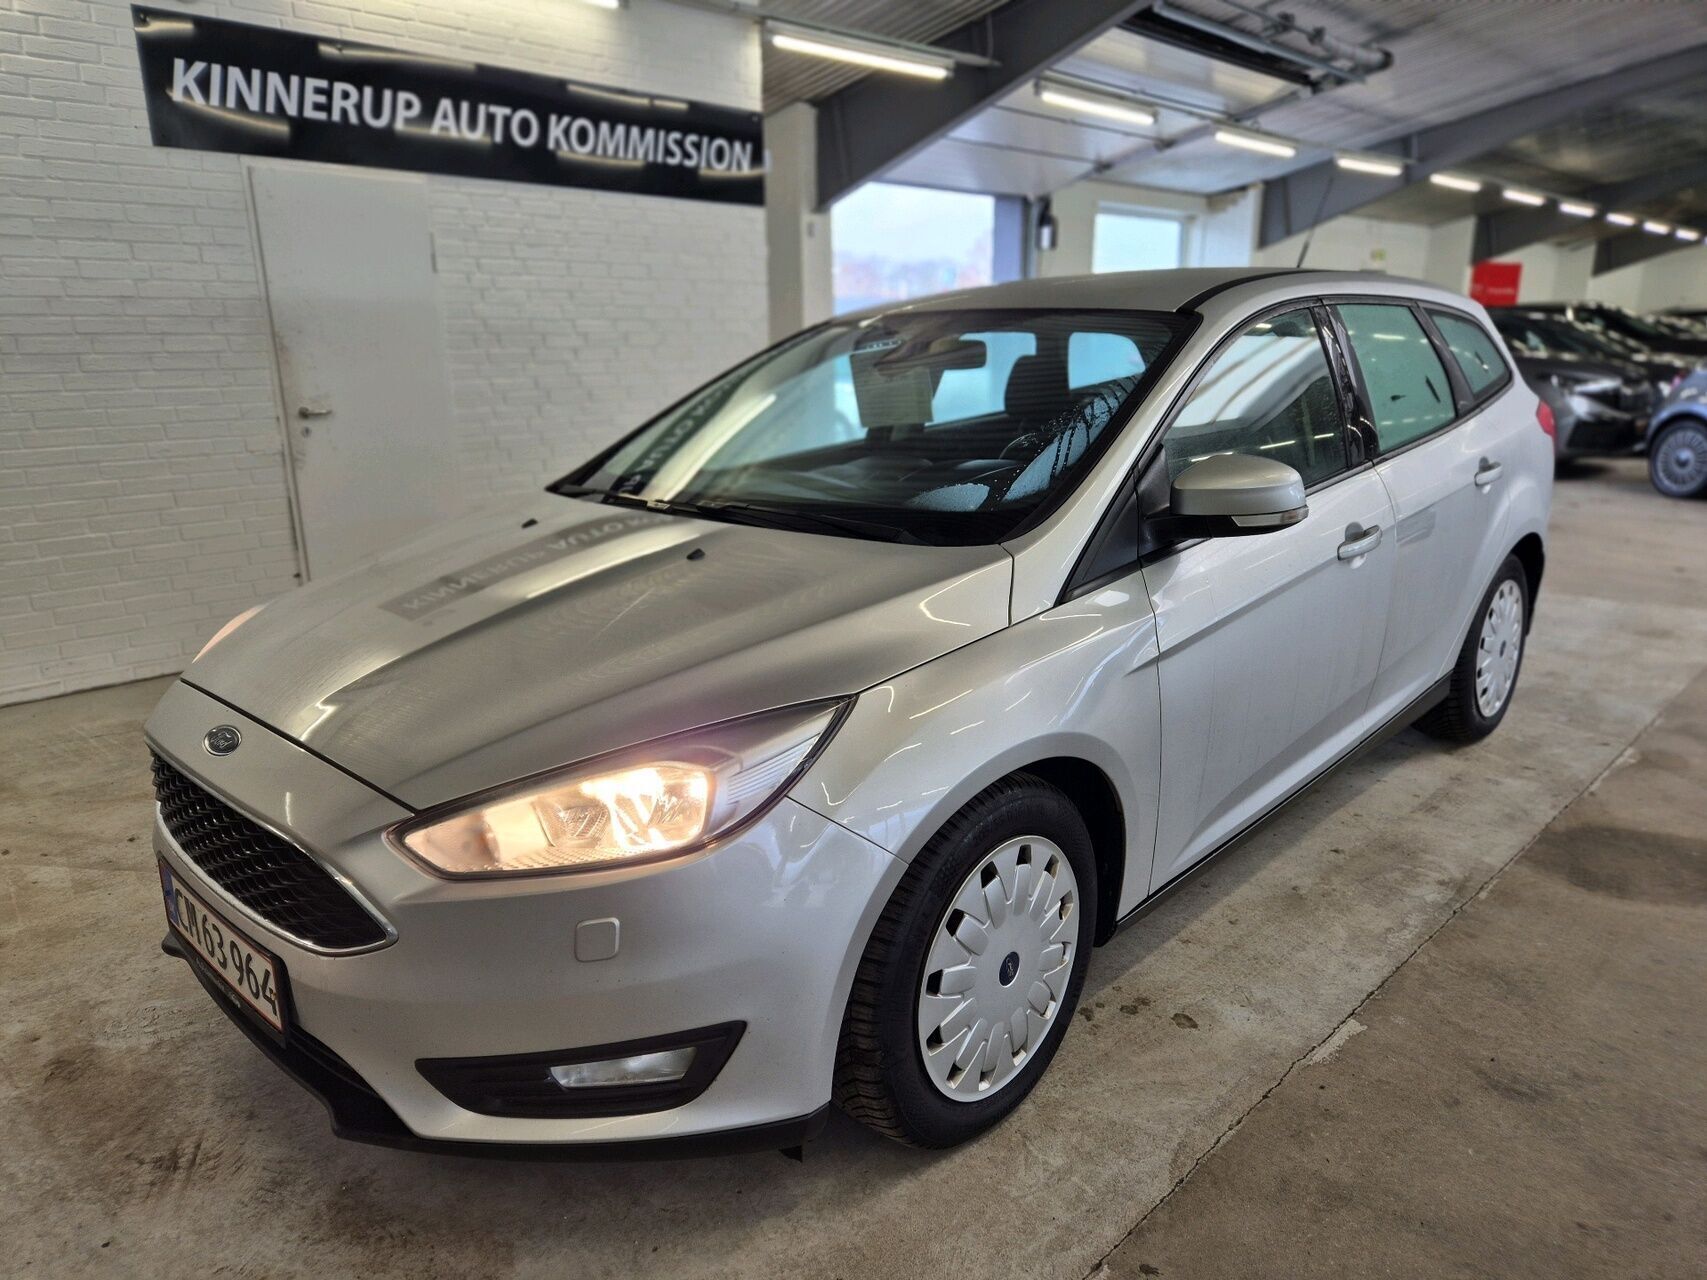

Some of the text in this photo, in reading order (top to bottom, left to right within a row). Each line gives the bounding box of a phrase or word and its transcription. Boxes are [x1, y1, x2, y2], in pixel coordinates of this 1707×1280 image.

[172, 57, 422, 130] KINNERUP
[429, 98, 540, 147] AUTO
[547, 113, 753, 174] KOMMISSION
